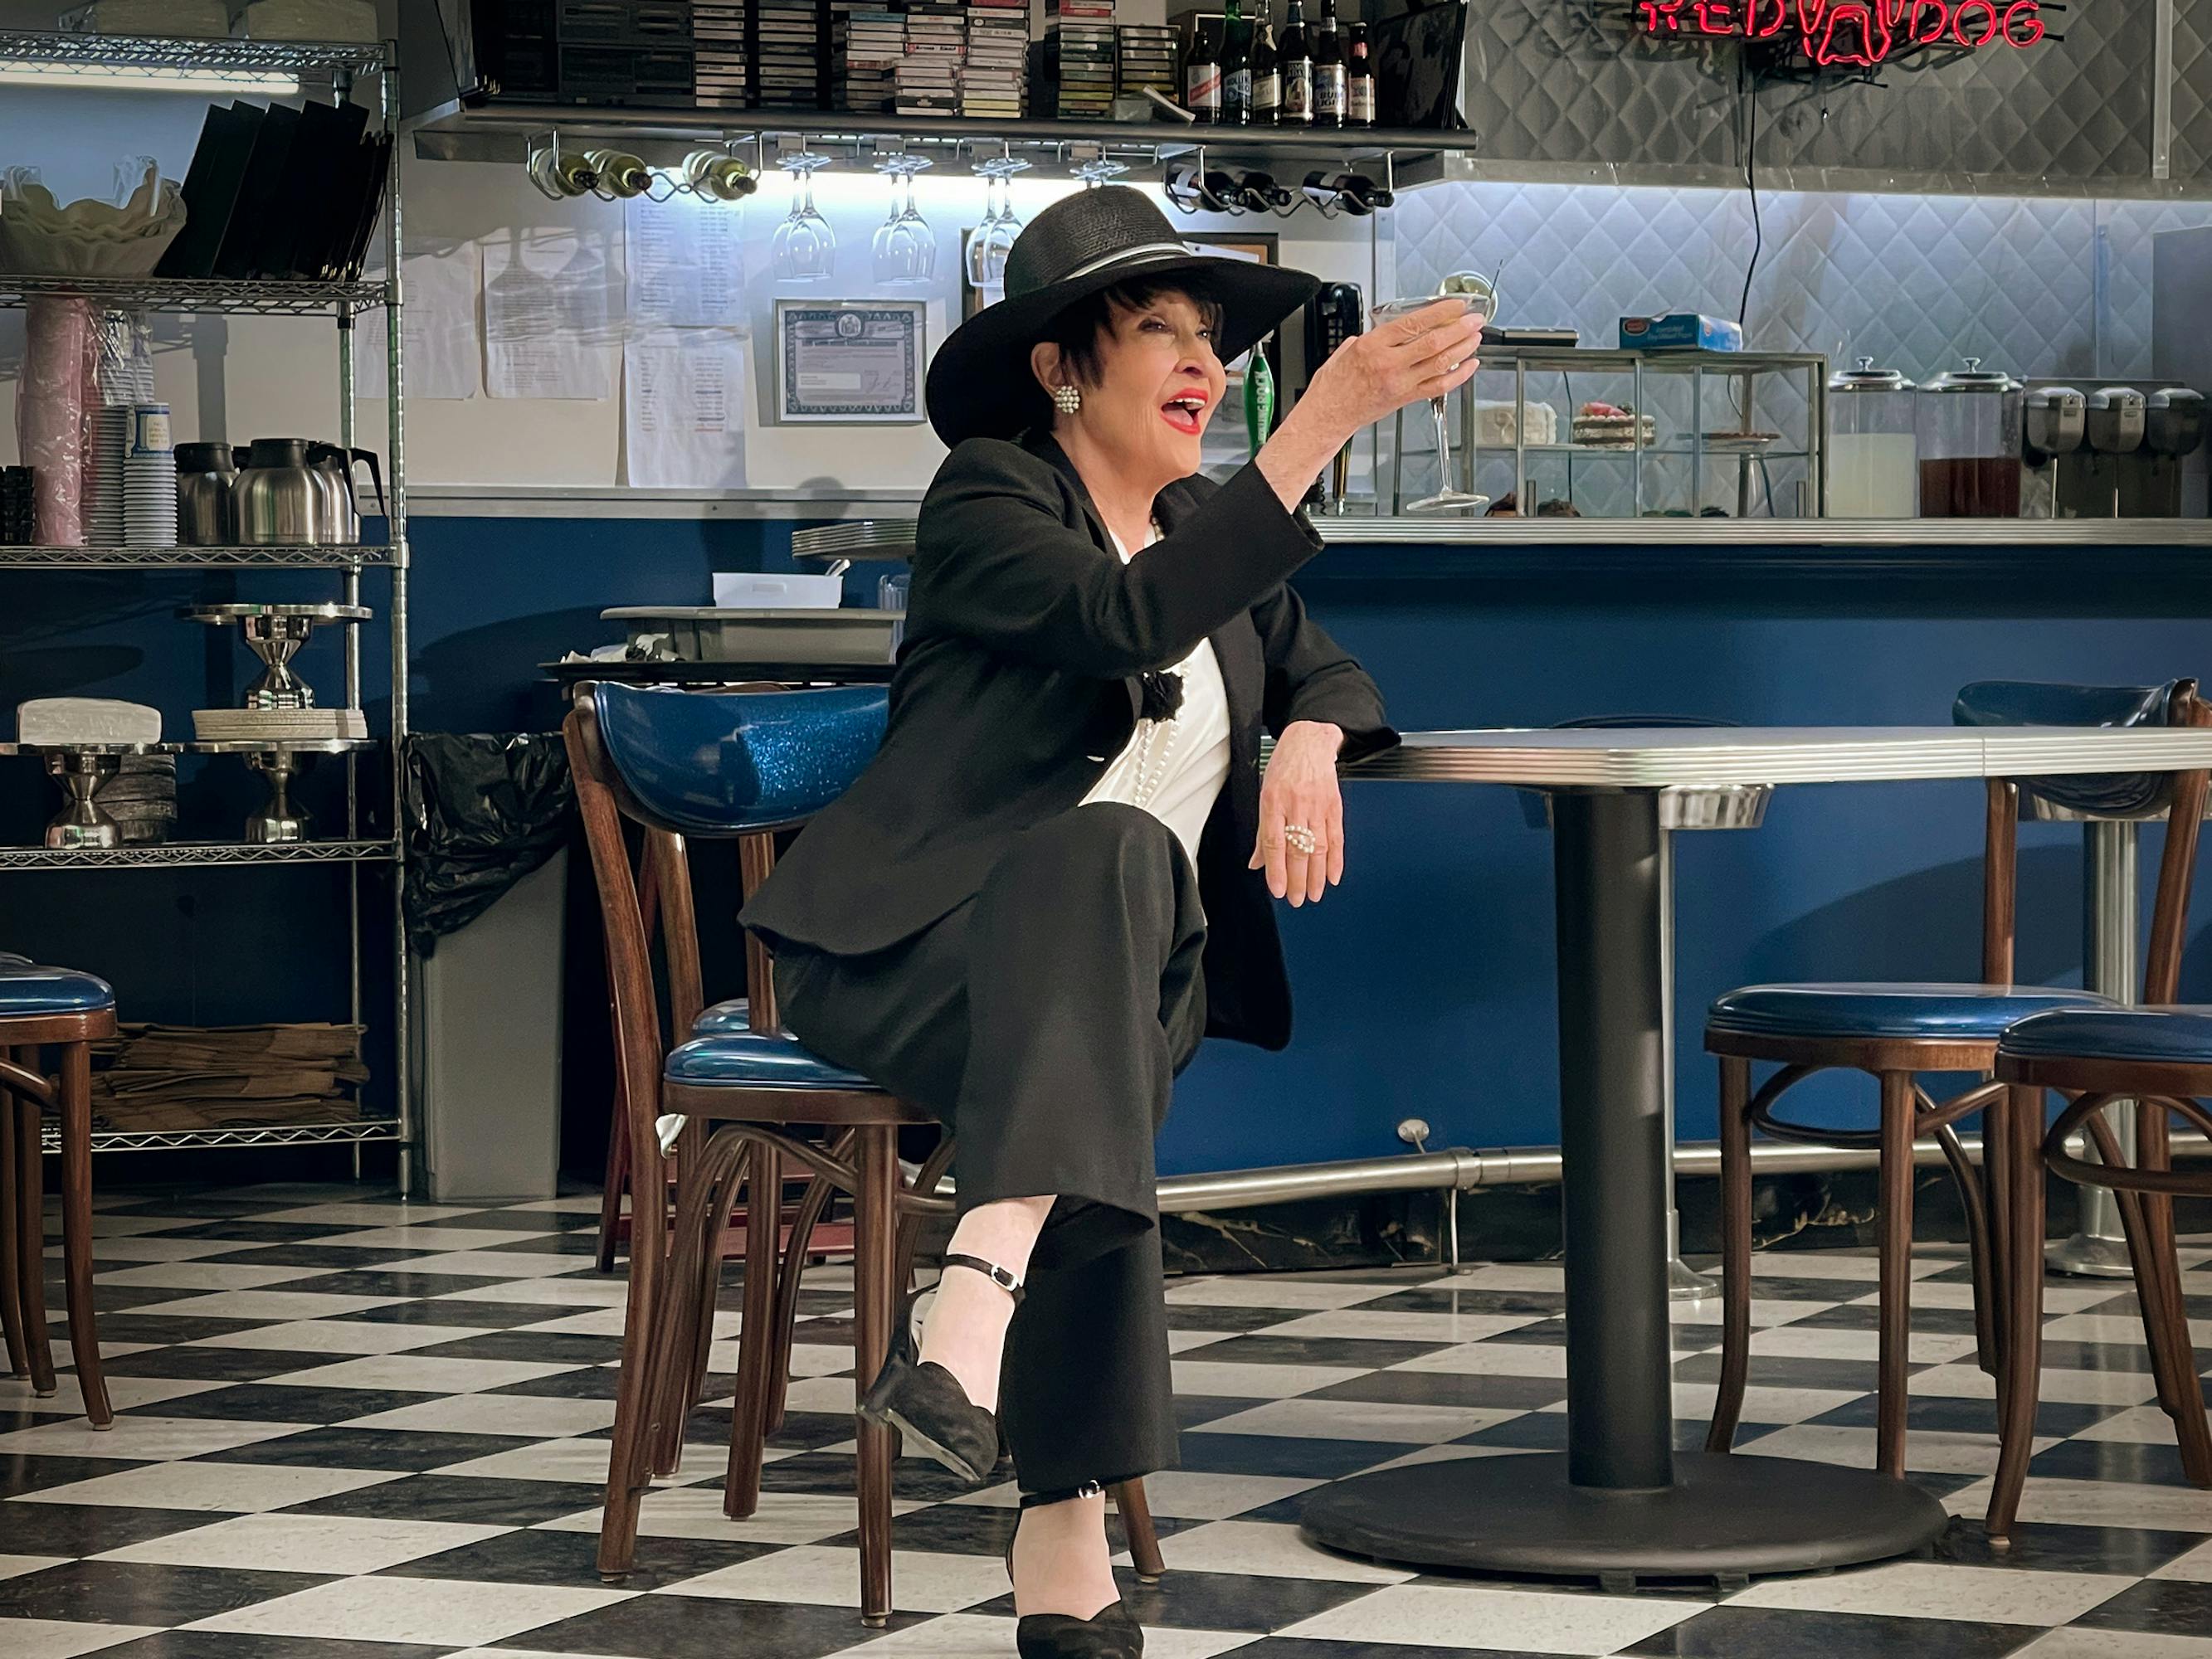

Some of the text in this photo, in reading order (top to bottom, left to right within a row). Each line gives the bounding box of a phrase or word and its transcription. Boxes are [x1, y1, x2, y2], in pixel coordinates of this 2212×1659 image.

[1640, 0, 2045, 49] RED DOG
[1254, 370, 1269, 404] ROCK
